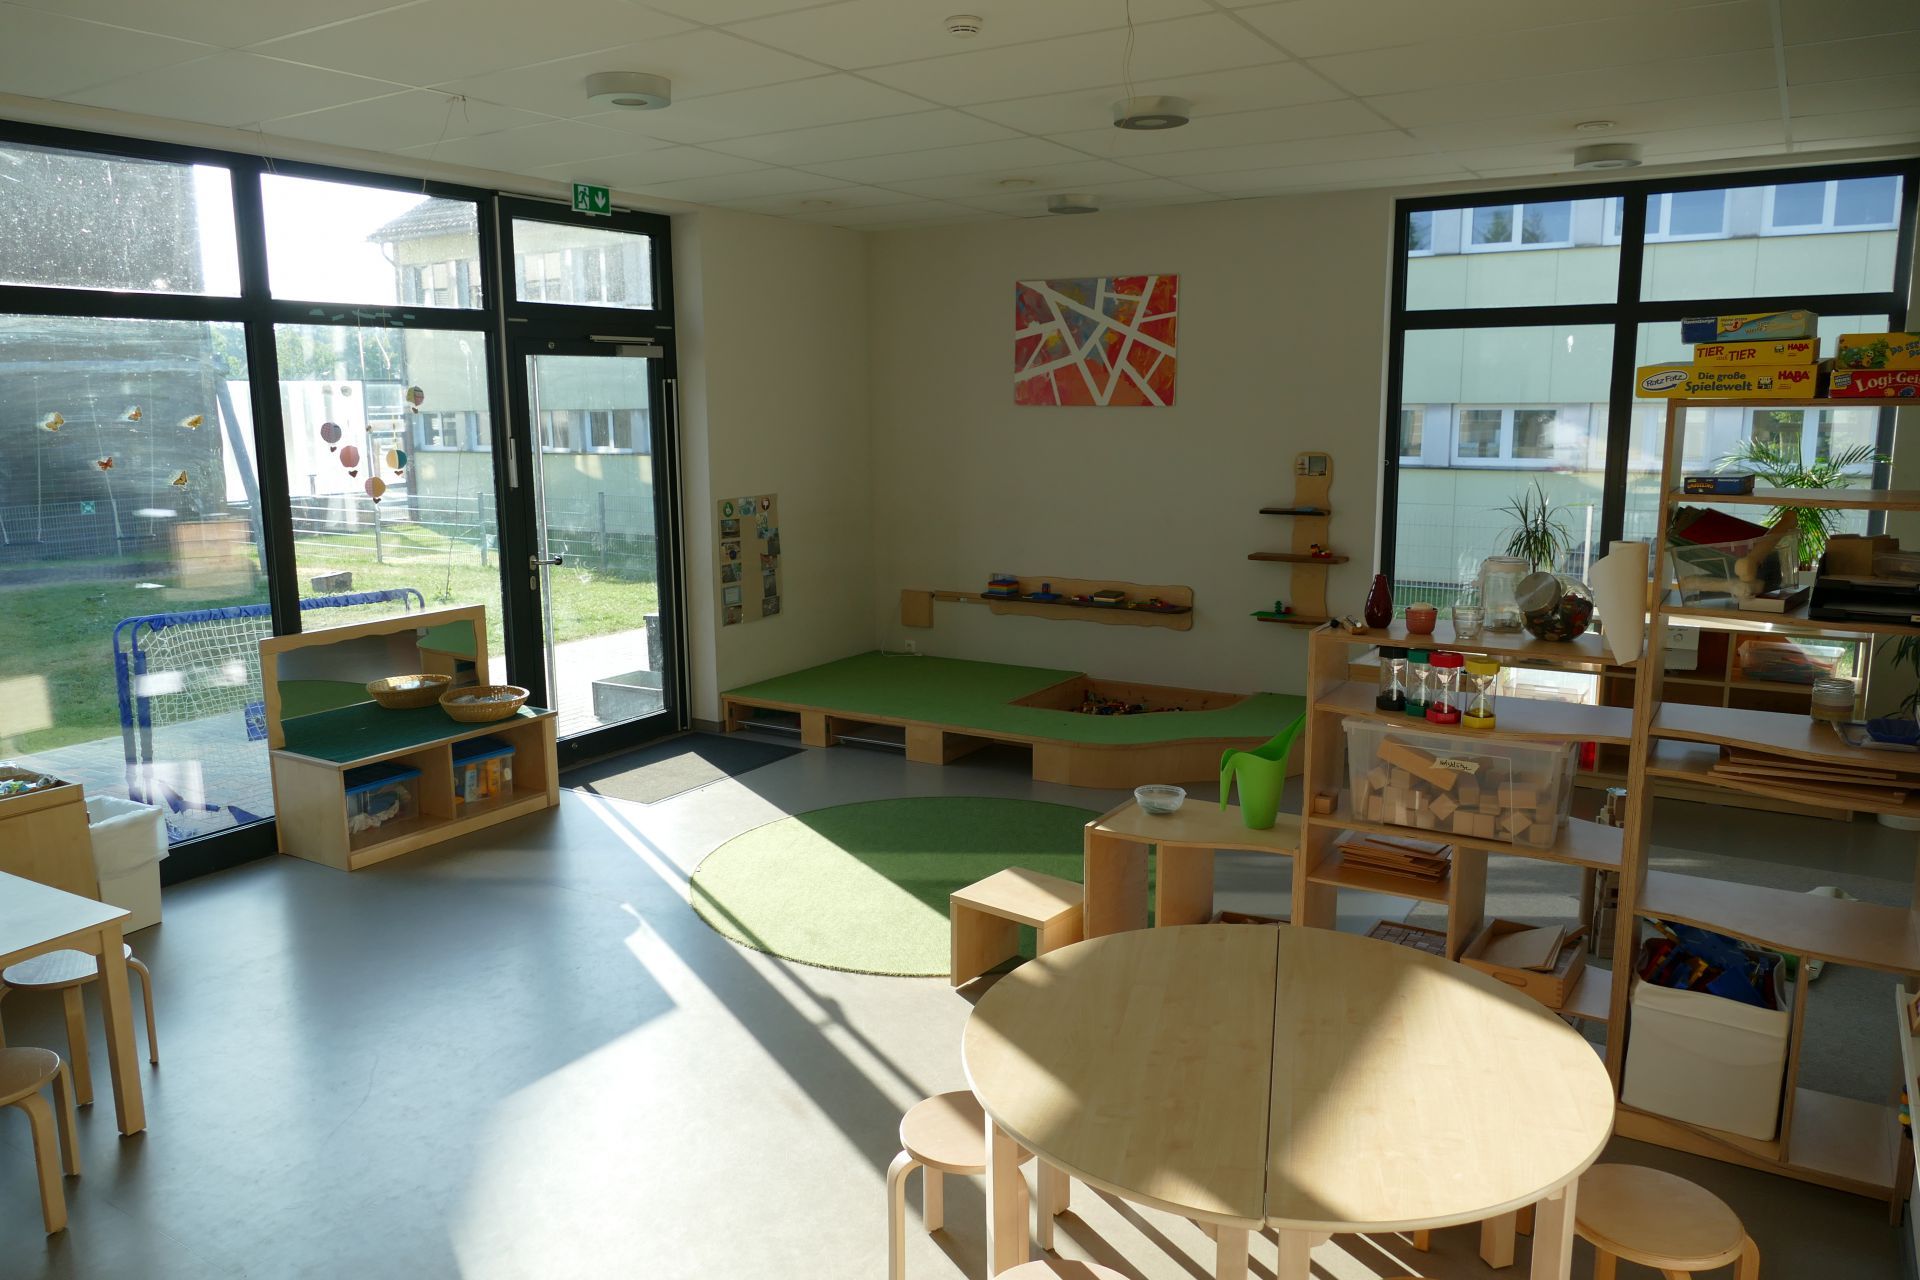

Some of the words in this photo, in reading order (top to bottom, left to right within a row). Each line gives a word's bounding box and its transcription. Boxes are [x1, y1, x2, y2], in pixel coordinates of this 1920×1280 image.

[1697, 346, 1724, 358] TIER
[1728, 348, 1756, 361] TIER
[1787, 343, 1809, 352] HABA
[1698, 372, 1715, 380] Die
[1717, 372, 1746, 381] große
[1778, 370, 1810, 383] HABA
[1854, 371, 1920, 392] Logi-Gei
[1685, 381, 1752, 394] Spielewelt
